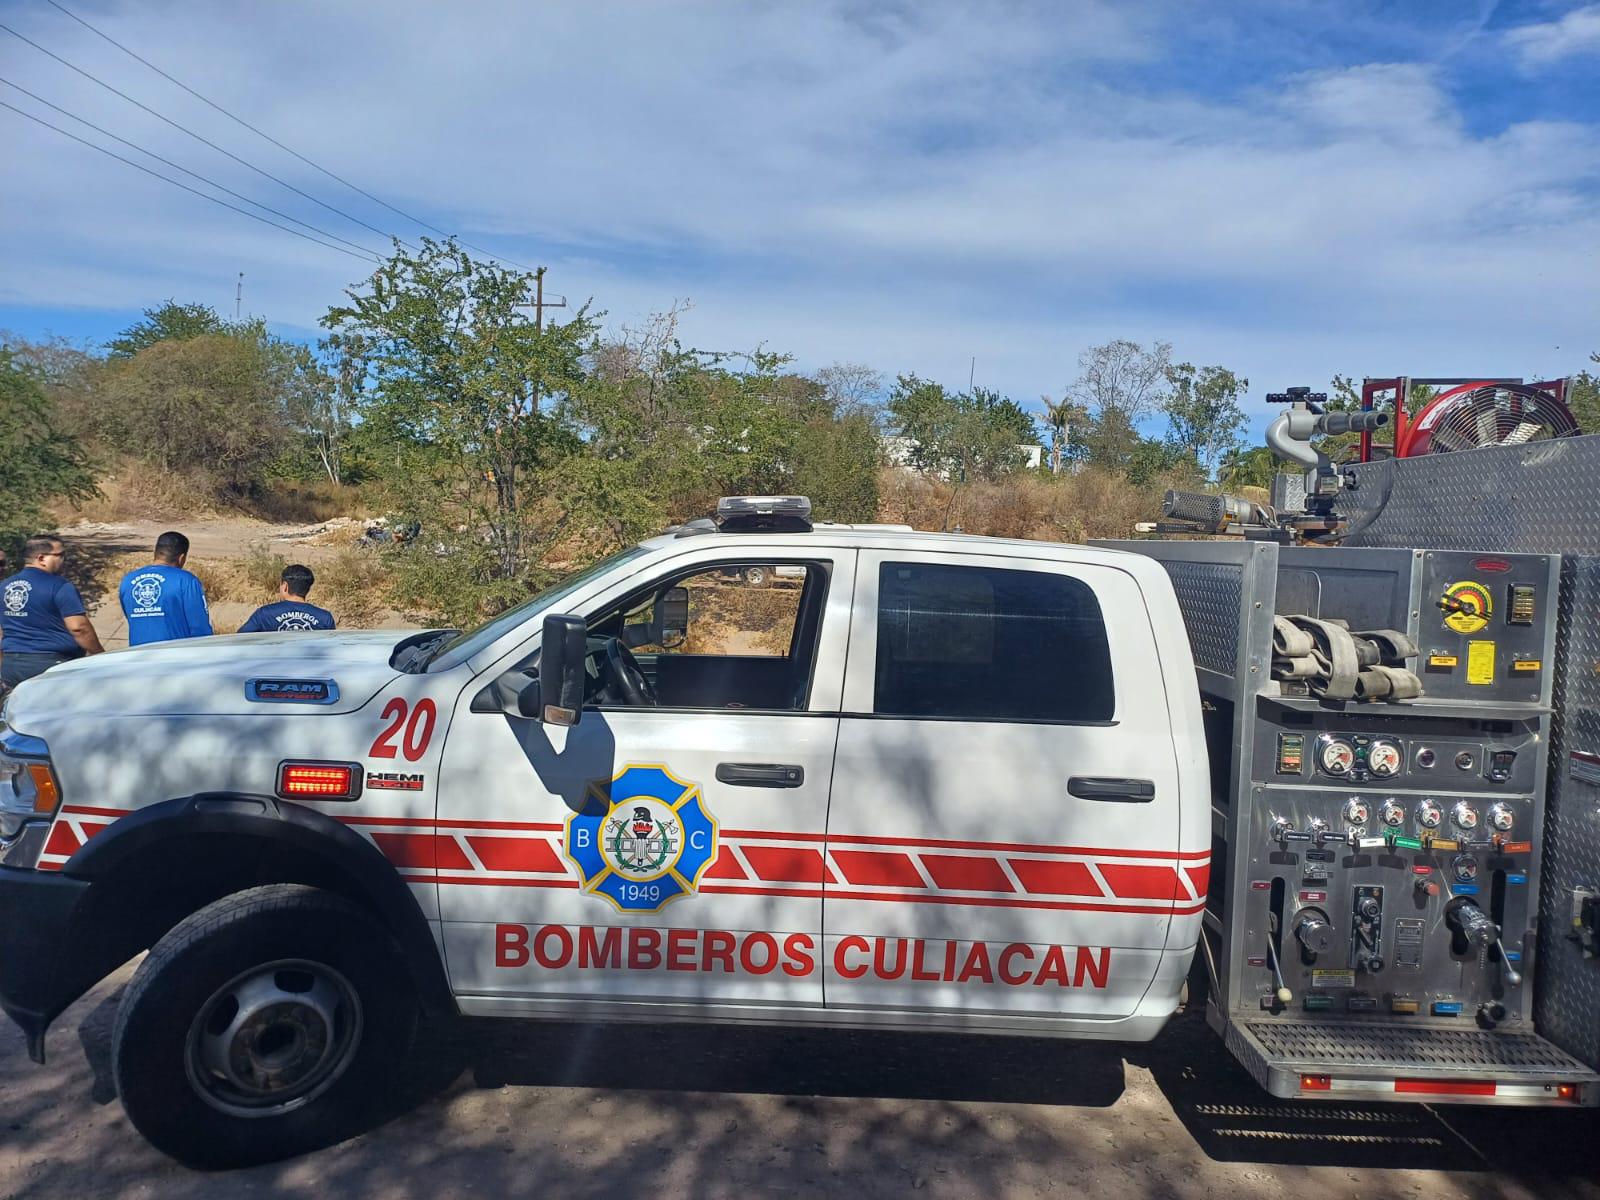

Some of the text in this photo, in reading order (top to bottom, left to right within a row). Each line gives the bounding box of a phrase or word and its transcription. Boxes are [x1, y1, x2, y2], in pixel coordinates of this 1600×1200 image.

[275, 611, 320, 625] BOMBEROS
[259, 683, 322, 692] RAM
[368, 697, 437, 762] 20
[367, 772, 425, 782] HEMI
[577, 828, 705, 850] B C
[618, 885, 660, 902] 1949
[495, 923, 1110, 990] BOMBEROS CULIACAN
